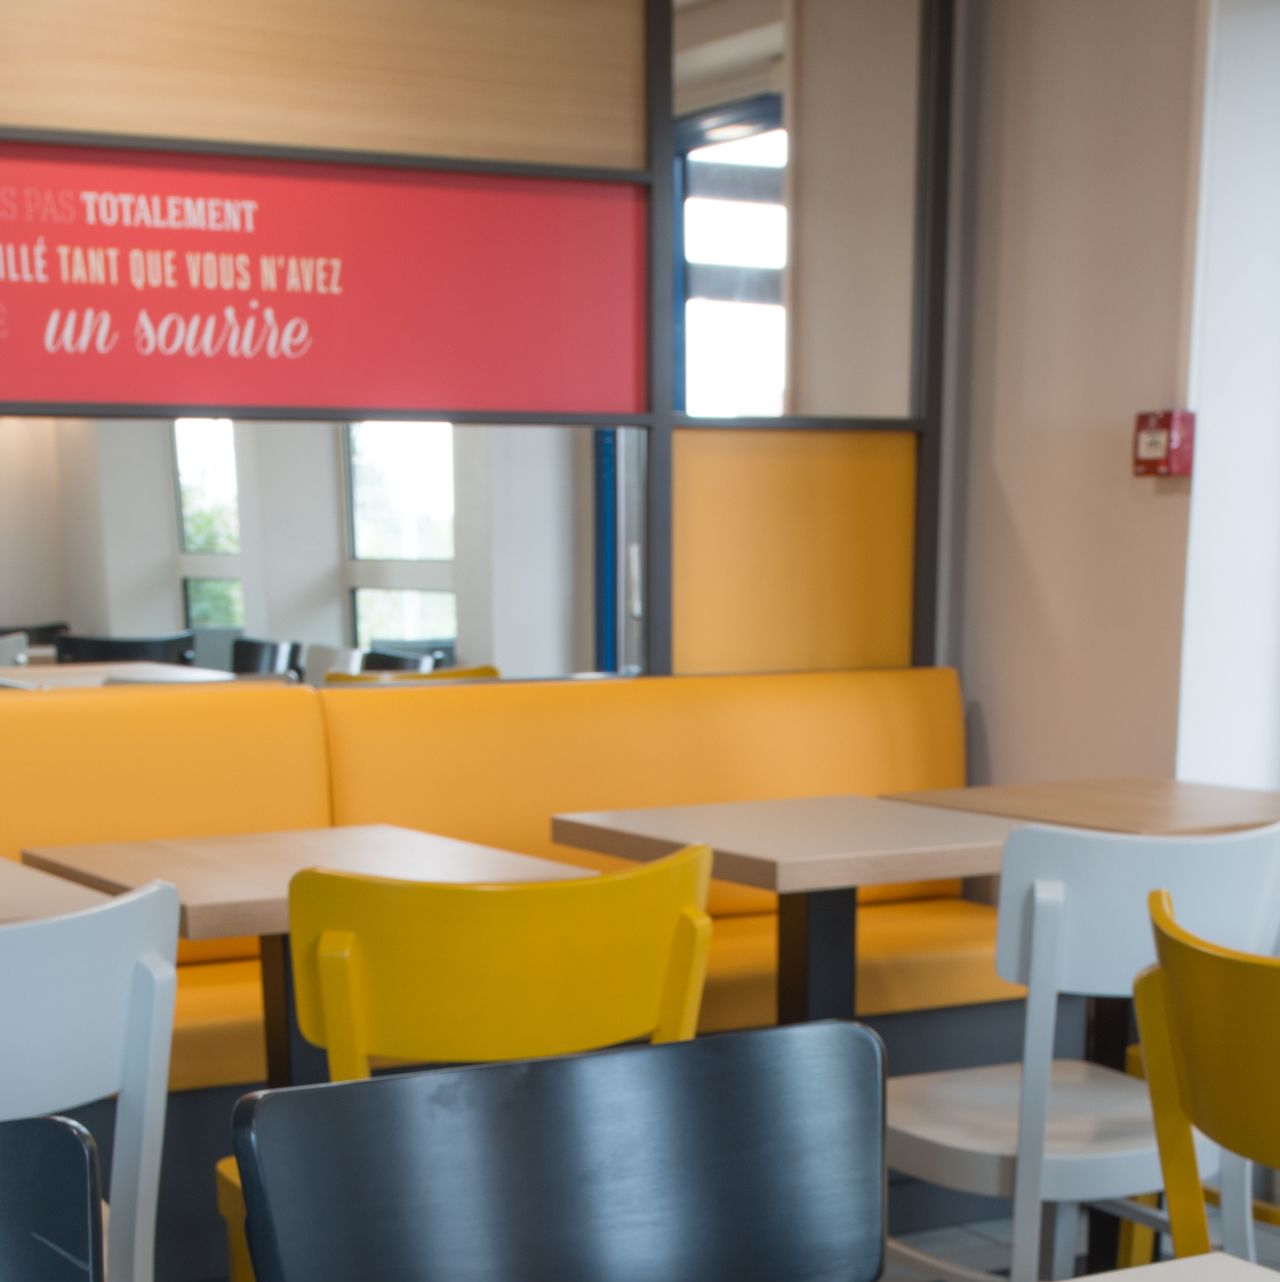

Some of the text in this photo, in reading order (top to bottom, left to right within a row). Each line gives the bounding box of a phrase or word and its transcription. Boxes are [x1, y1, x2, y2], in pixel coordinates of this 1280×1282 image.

[24, 190, 75, 224] PAS
[80, 190, 258, 233] TOTALEMENT
[57, 245, 119, 285] TANT
[128, 248, 177, 290] QUE
[186, 251, 251, 291] VOUS
[261, 255, 343, 294] N'AVEZ
[43, 307, 119, 354] un
[133, 299, 313, 359] sourire
